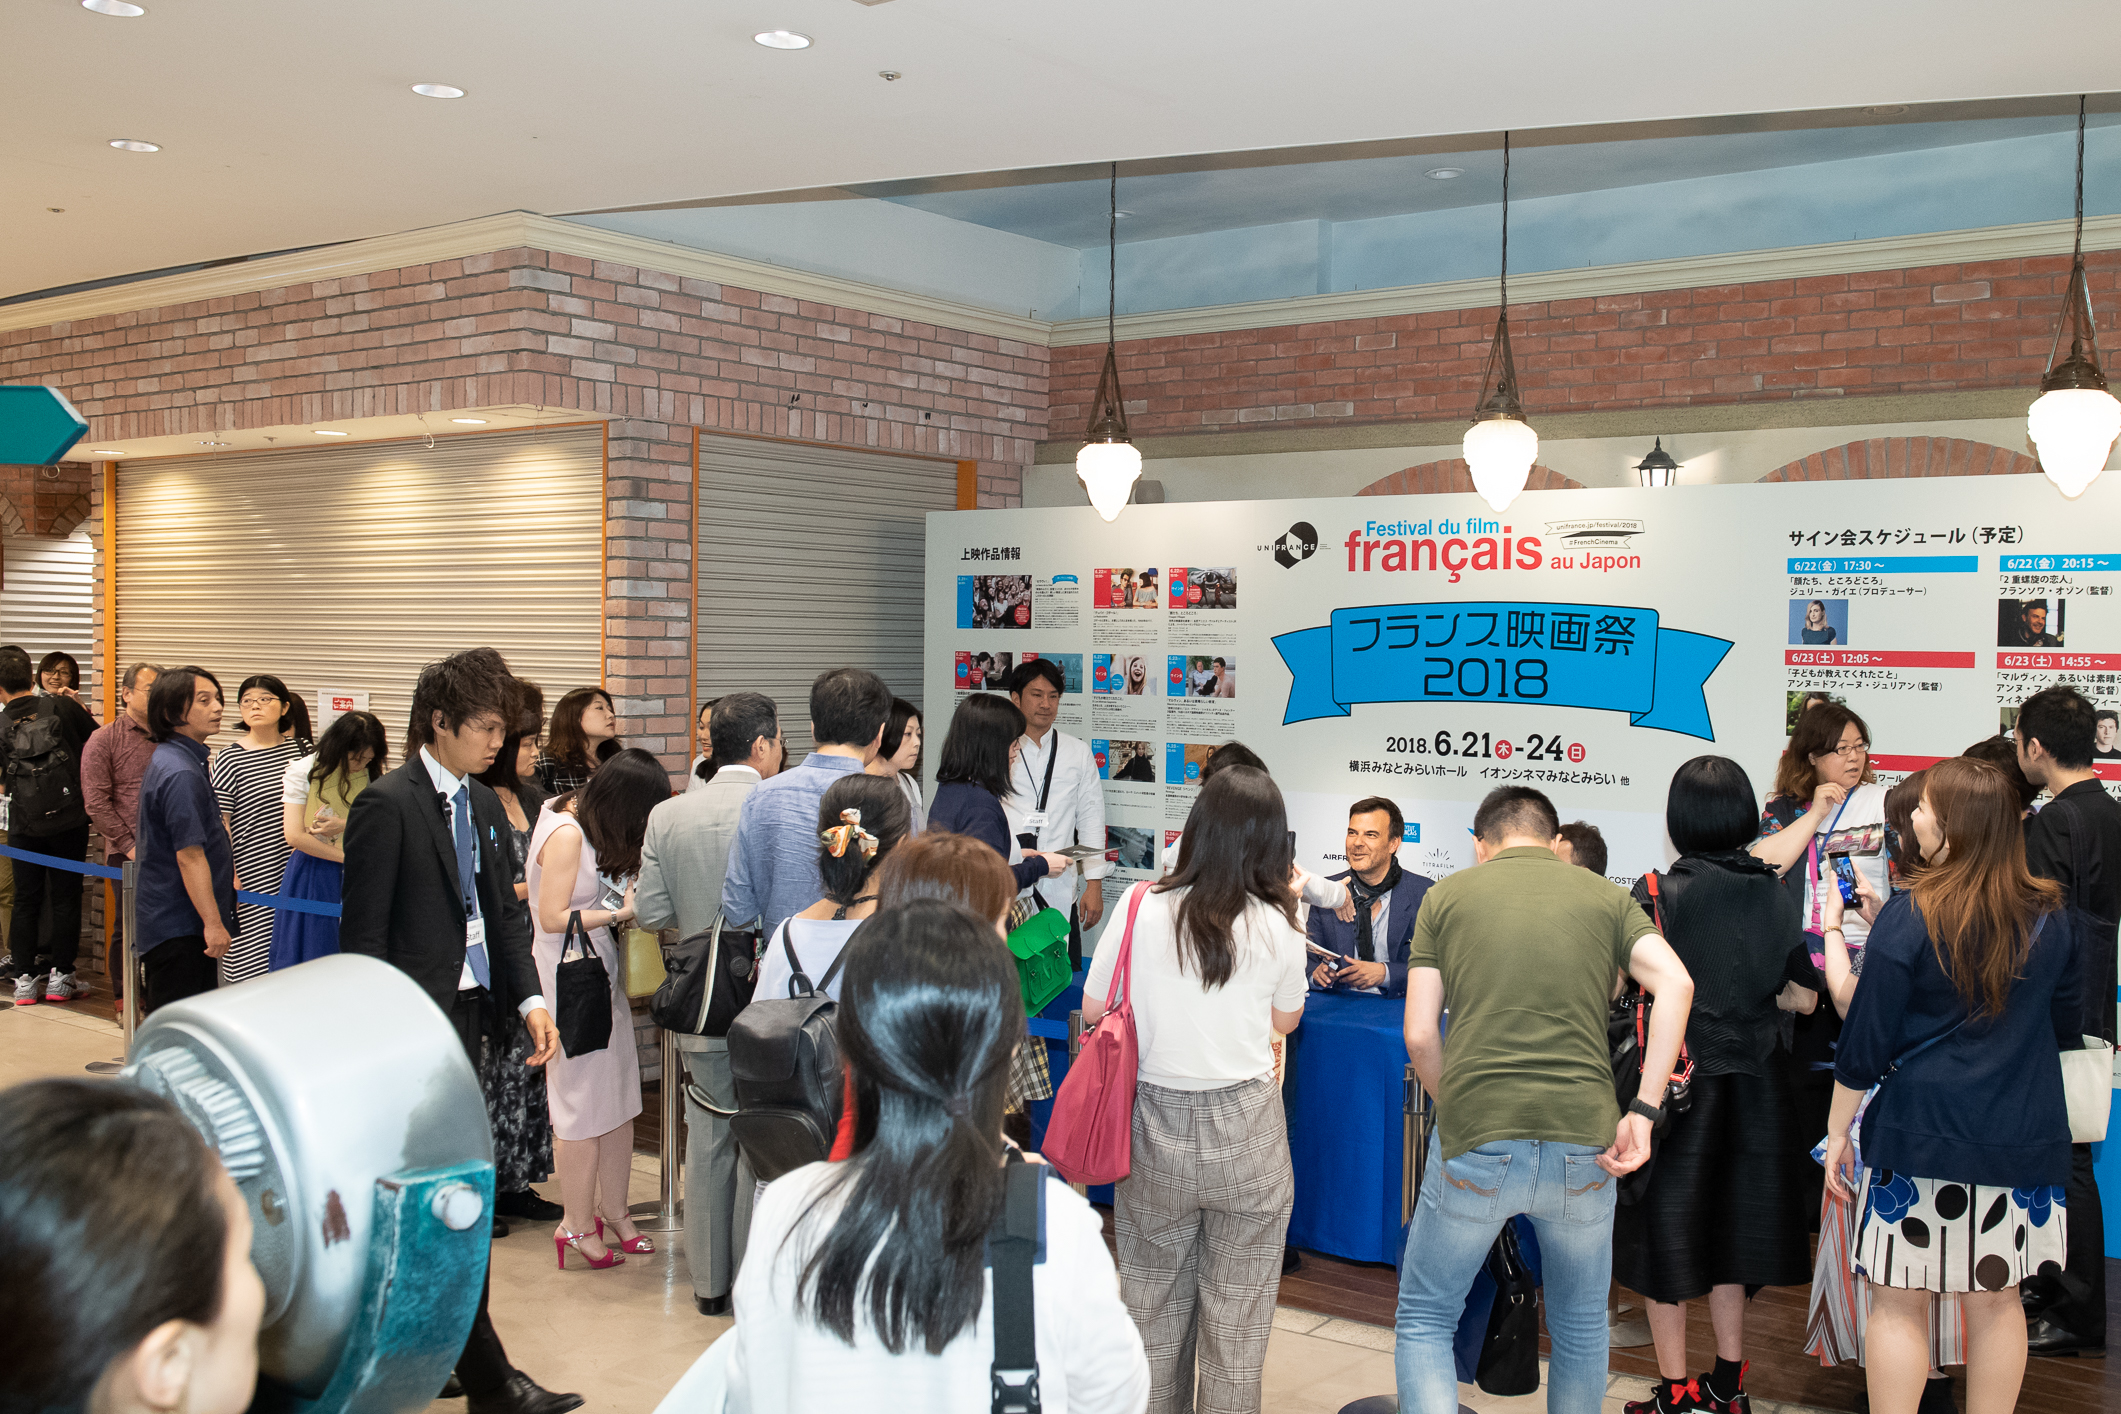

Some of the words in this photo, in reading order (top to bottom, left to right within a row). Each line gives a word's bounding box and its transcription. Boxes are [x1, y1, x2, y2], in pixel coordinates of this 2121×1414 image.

[1366, 519, 1432, 537] Festival
[1438, 519, 1460, 535] du
[1466, 518, 1500, 534] film
[1556, 522, 1638, 530] unifrance.jp/festival/2018
[960, 547, 1021, 561] 上映作品情報
[1257, 543, 1316, 551] UNIFRANCE
[1344, 525, 1543, 583] français
[1550, 556, 1574, 570] au
[1579, 552, 1641, 573] Japon
[1350, 611, 1636, 656] フランス映画祭
[1424, 657, 1548, 698] 2018
[1349, 760, 1468, 778] 横浜みなとみらいホール
[1480, 768, 1616, 785] イオンシネマみなとみらい
[1620, 775, 1630, 786] 他
[1322, 853, 1348, 861] AIRFR
[1422, 861, 1455, 869] TITRAFILM
